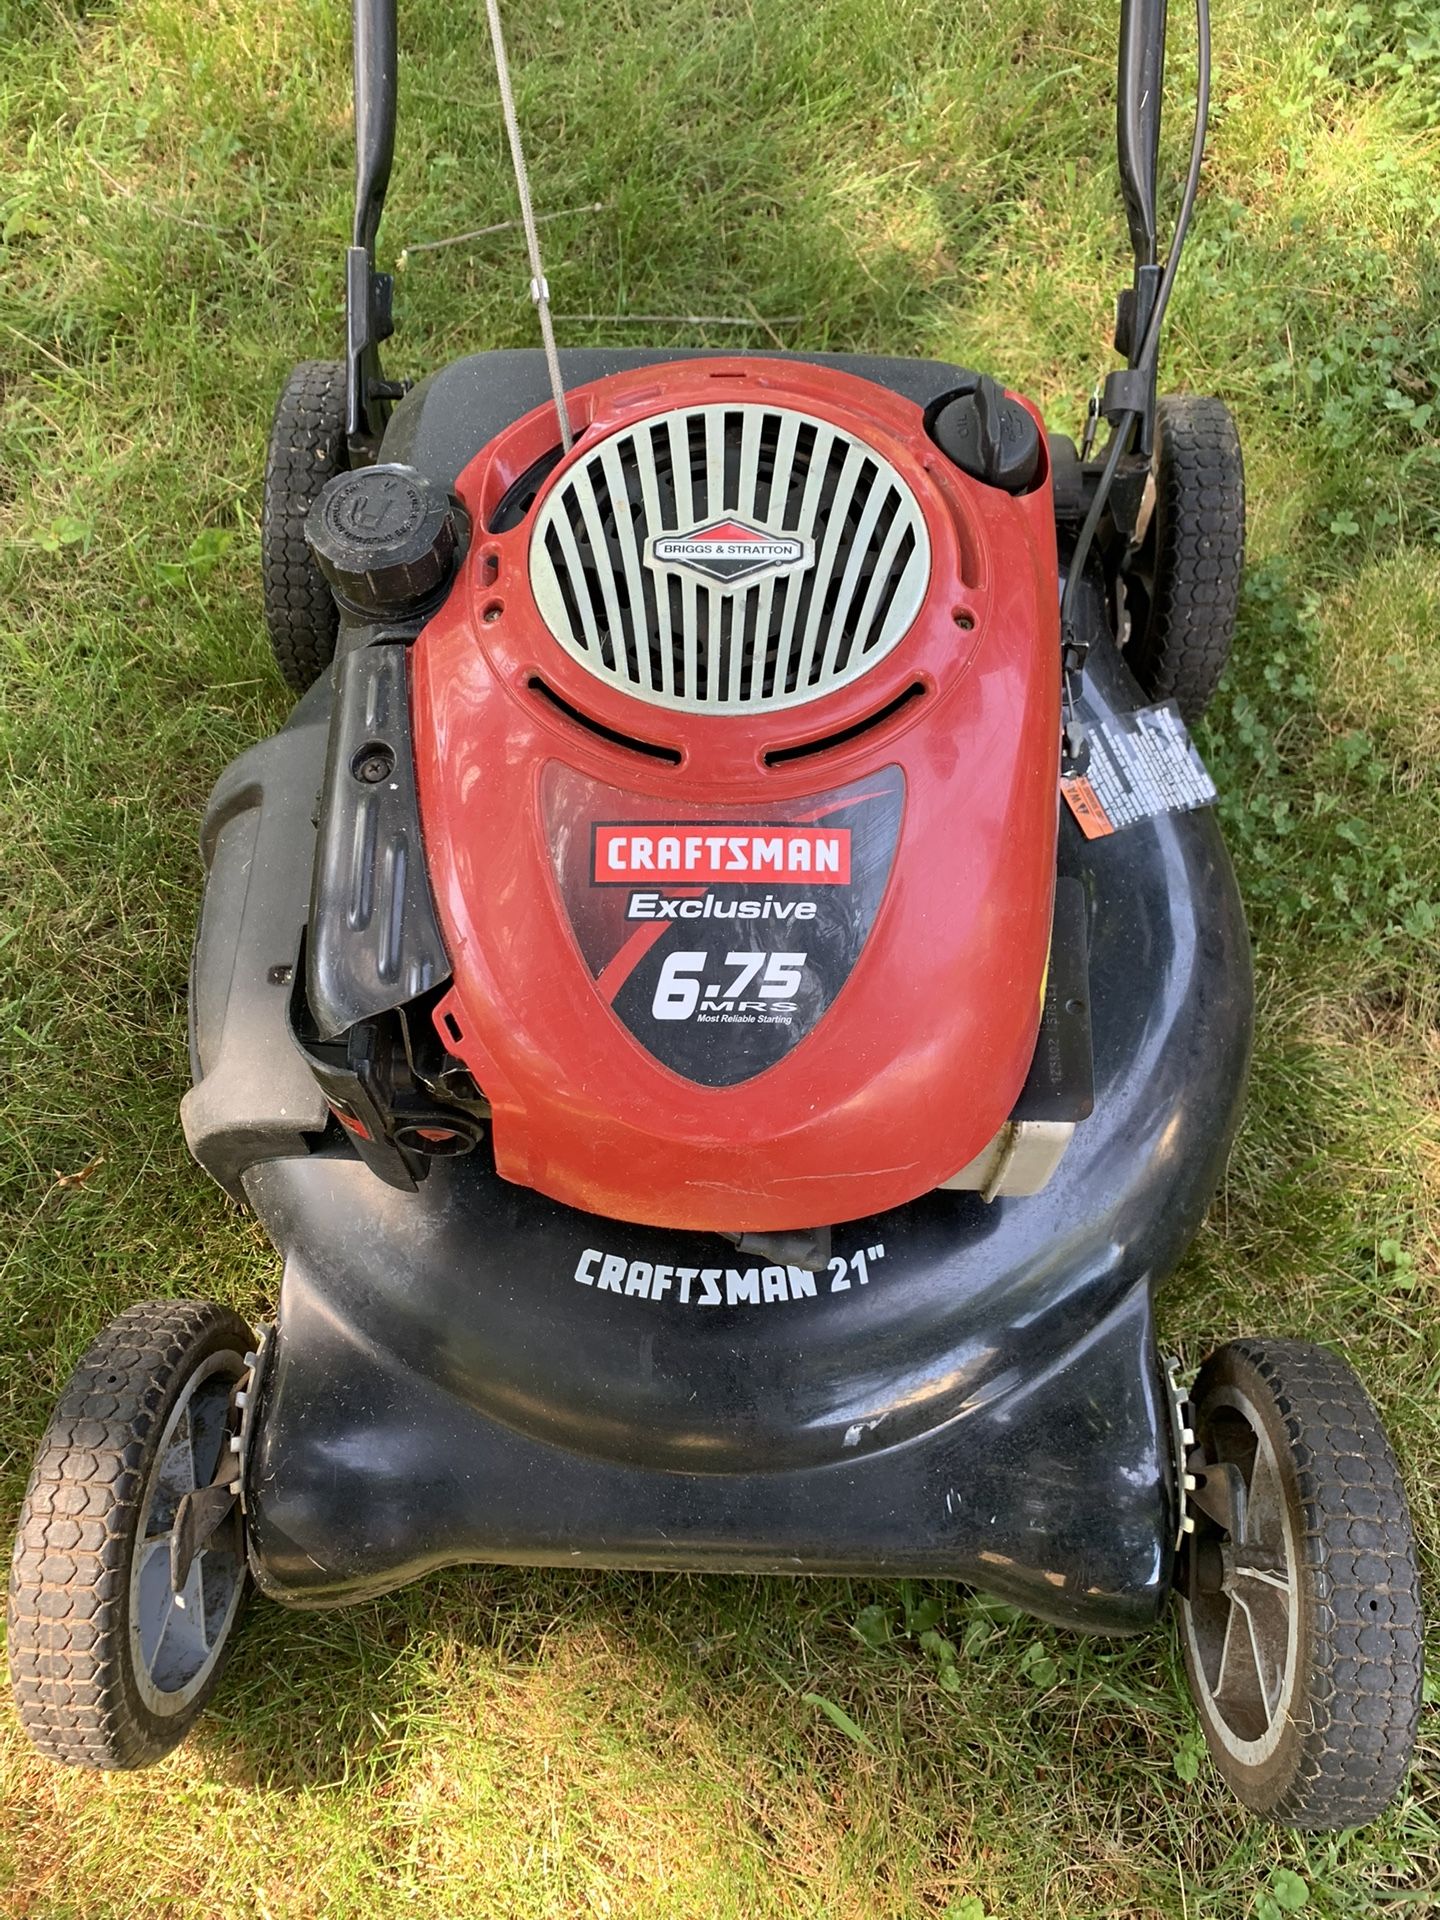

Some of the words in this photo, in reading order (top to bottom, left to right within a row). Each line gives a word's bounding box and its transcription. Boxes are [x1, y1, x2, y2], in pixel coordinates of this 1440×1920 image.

[956, 414, 969, 438] OIL
[664, 544, 712, 554] BRIGGS
[715, 544, 724, 554] &
[727, 545, 793, 555] STRATTON
[607, 836, 840, 872] CRAFTSMAN
[628, 893, 817, 919] Exclusive
[652, 951, 807, 1020] 6.75
[700, 1001, 798, 1012] MRS
[697, 1014, 719, 1023] Most
[721, 1014, 756, 1024] Reliable
[757, 1014, 792, 1026] Starting
[574, 1248, 818, 1305] CRAFTSMAN
[827, 1243, 885, 1293] 21"
